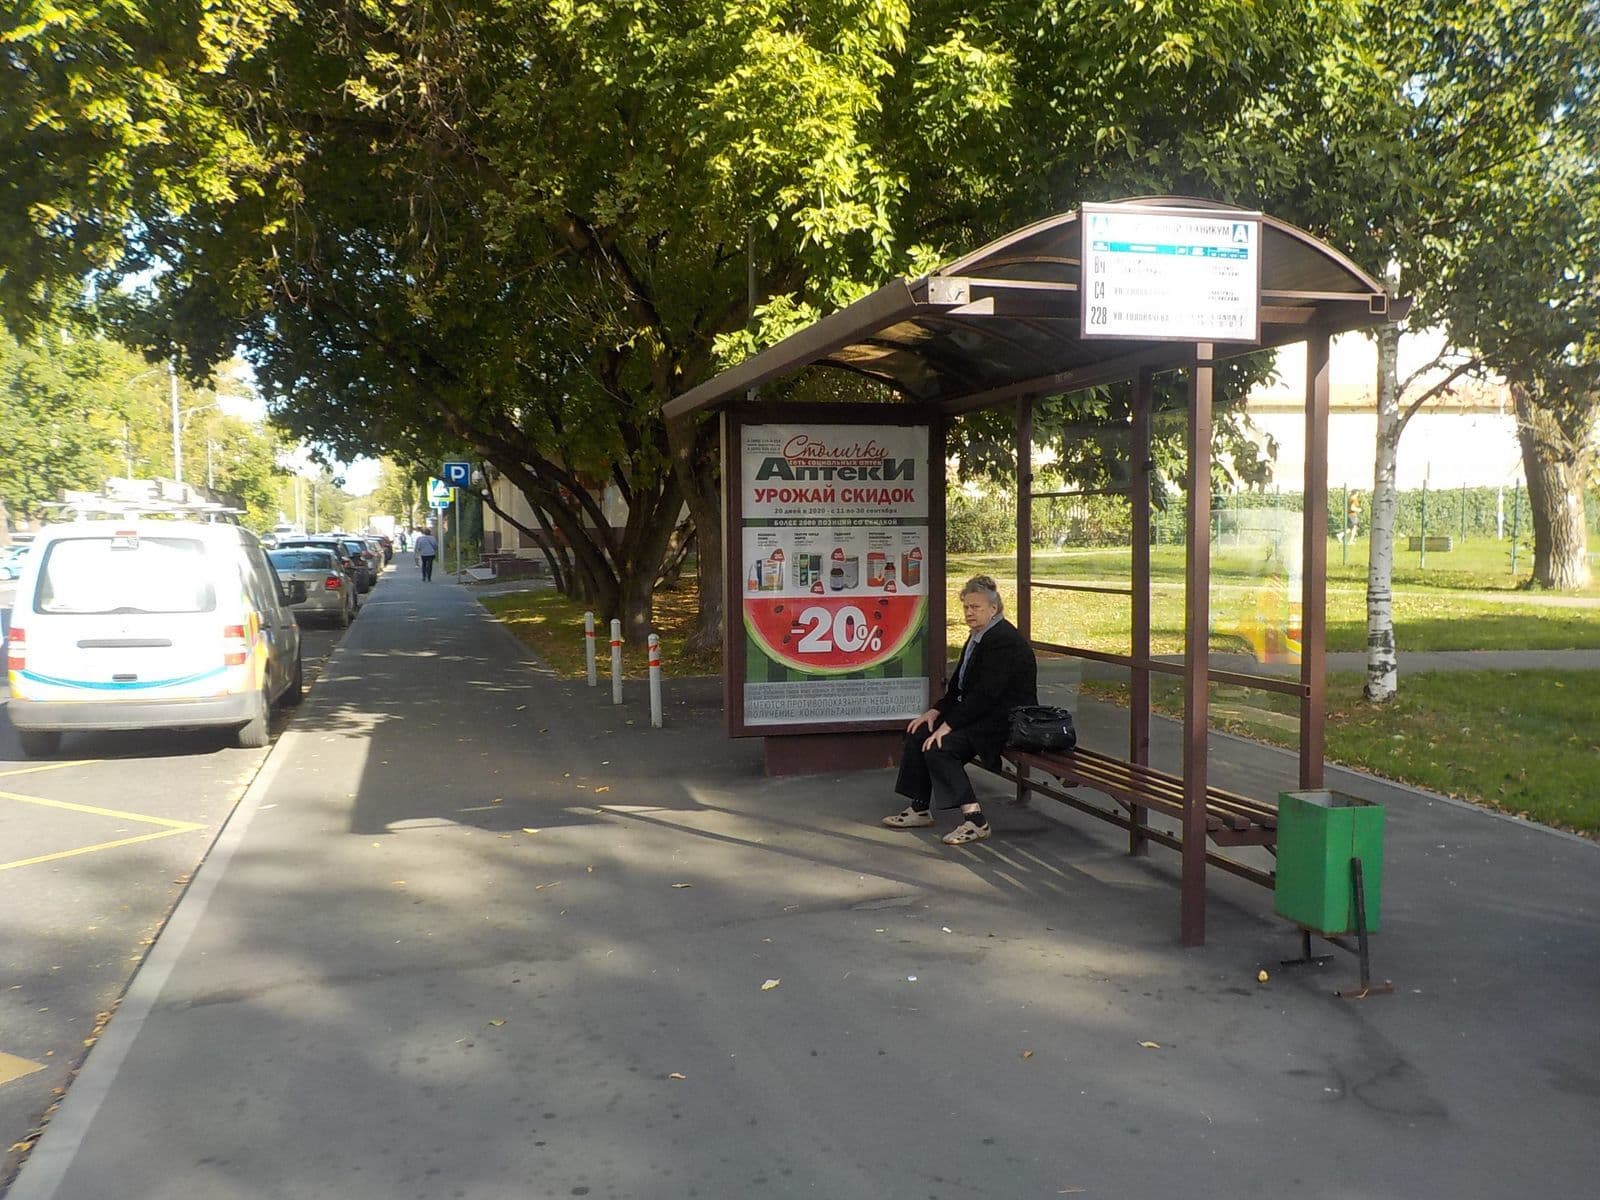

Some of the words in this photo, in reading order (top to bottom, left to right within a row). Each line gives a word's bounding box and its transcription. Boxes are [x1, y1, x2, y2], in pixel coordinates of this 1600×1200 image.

[1090, 306, 1107, 325] 228
[783, 434, 889, 459] Столички
[789, 459, 807, 467] сеть
[808, 459, 857, 467] социальных
[451, 466, 465, 481] P
[754, 484, 836, 503] УРОЖАЙ
[840, 488, 915, 505] СКИДОК
[774, 519, 798, 527] БОЛЕЕ
[817, 518, 851, 527] ПОЗИЦИЙ
[791, 606, 882, 653] -20%
